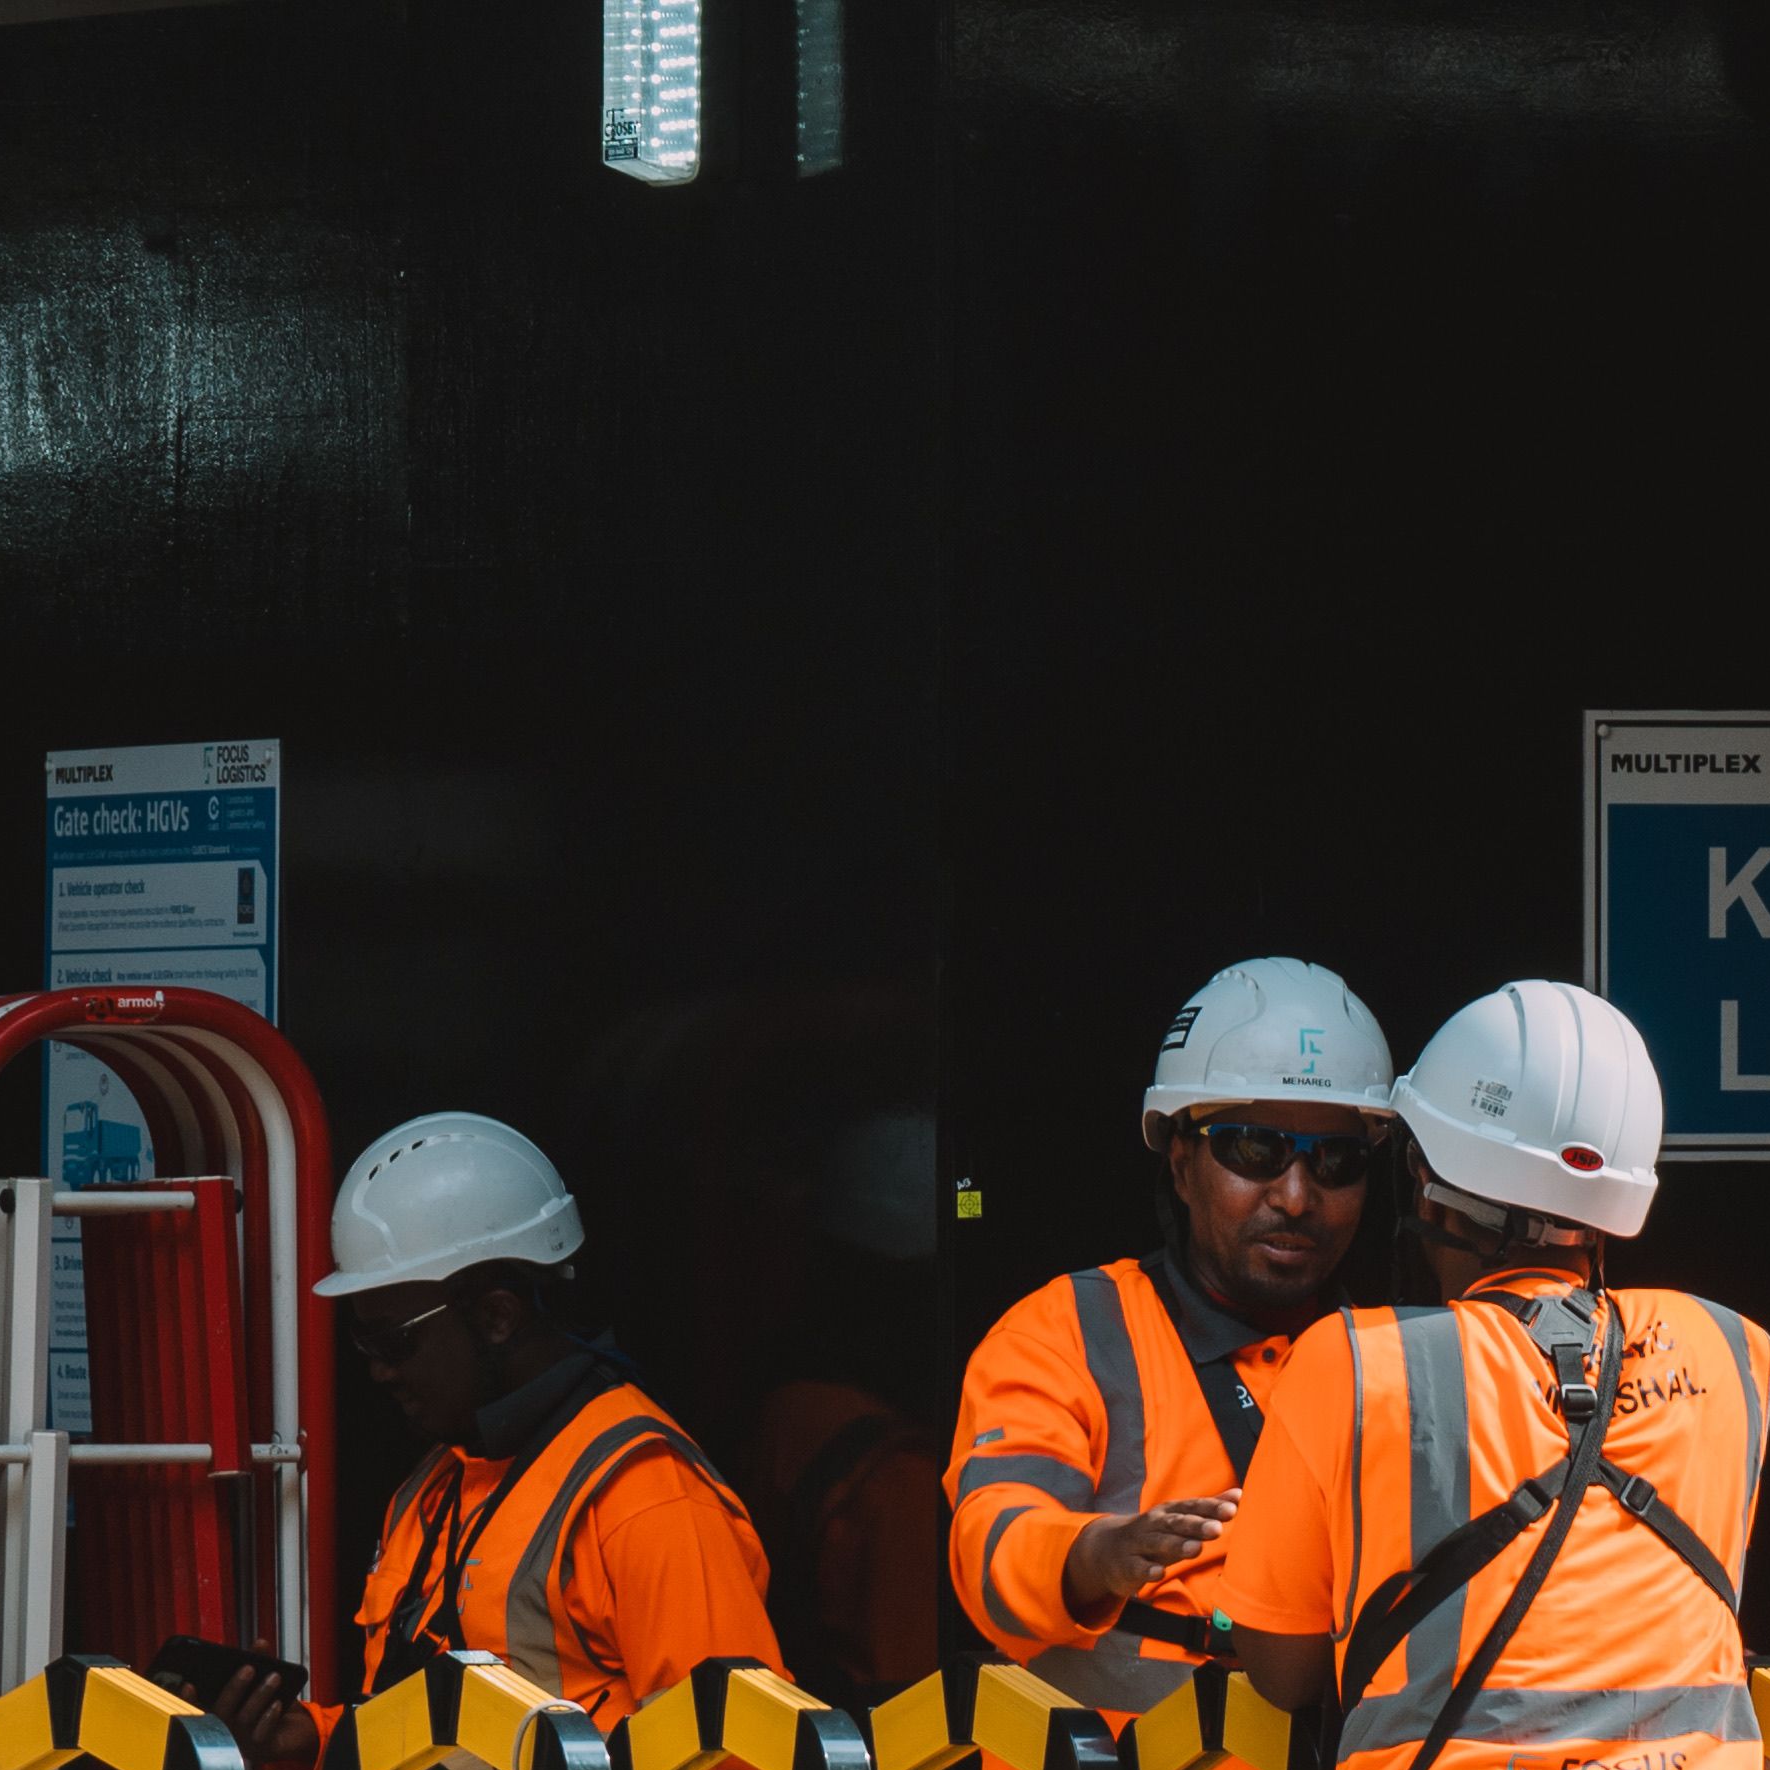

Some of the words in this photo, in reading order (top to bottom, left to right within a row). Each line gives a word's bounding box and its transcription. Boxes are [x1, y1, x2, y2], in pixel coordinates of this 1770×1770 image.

[217, 745, 249, 763] FOCUS
[1611, 753, 1761, 774] MULTIPLEX
[56, 765, 113, 784] MULTIPLEX
[217, 765, 267, 784] LOGISTICS
[54, 805, 89, 838] Gate
[93, 801, 143, 836] check:
[146, 799, 190, 833] HGVs
[1282, 1077, 1331, 1088] MEHAREG
